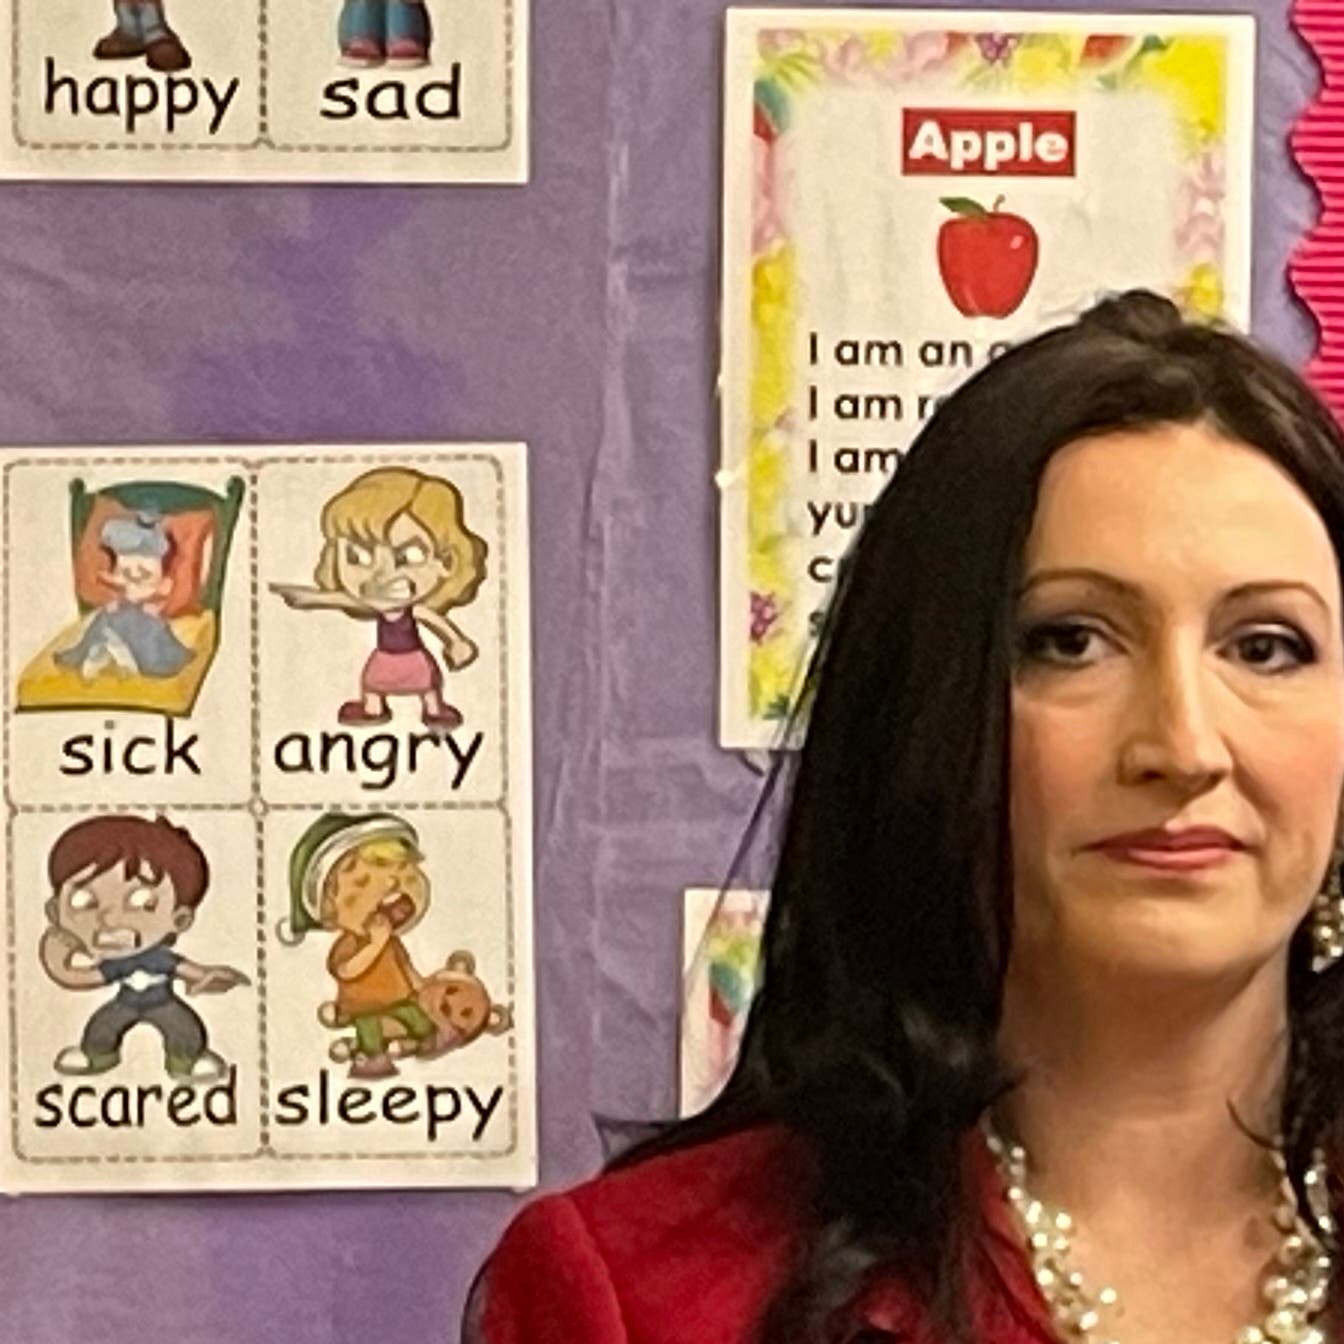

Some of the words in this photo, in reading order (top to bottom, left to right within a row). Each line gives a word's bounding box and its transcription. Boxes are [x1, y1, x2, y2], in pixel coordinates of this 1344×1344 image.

[44, 57, 240, 135] happy
[319, 62, 462, 120] sad
[908, 119, 1069, 172] Apple
[809, 332, 818, 366] I
[834, 340, 903, 367] am
[919, 340, 973, 367] an
[809, 385, 818, 419] I
[834, 393, 903, 420] am
[809, 439, 818, 473] I
[59, 718, 202, 776] sick
[273, 724, 484, 790] angry
[34, 1064, 239, 1129] scared
[275, 1070, 505, 1141] sleepy
